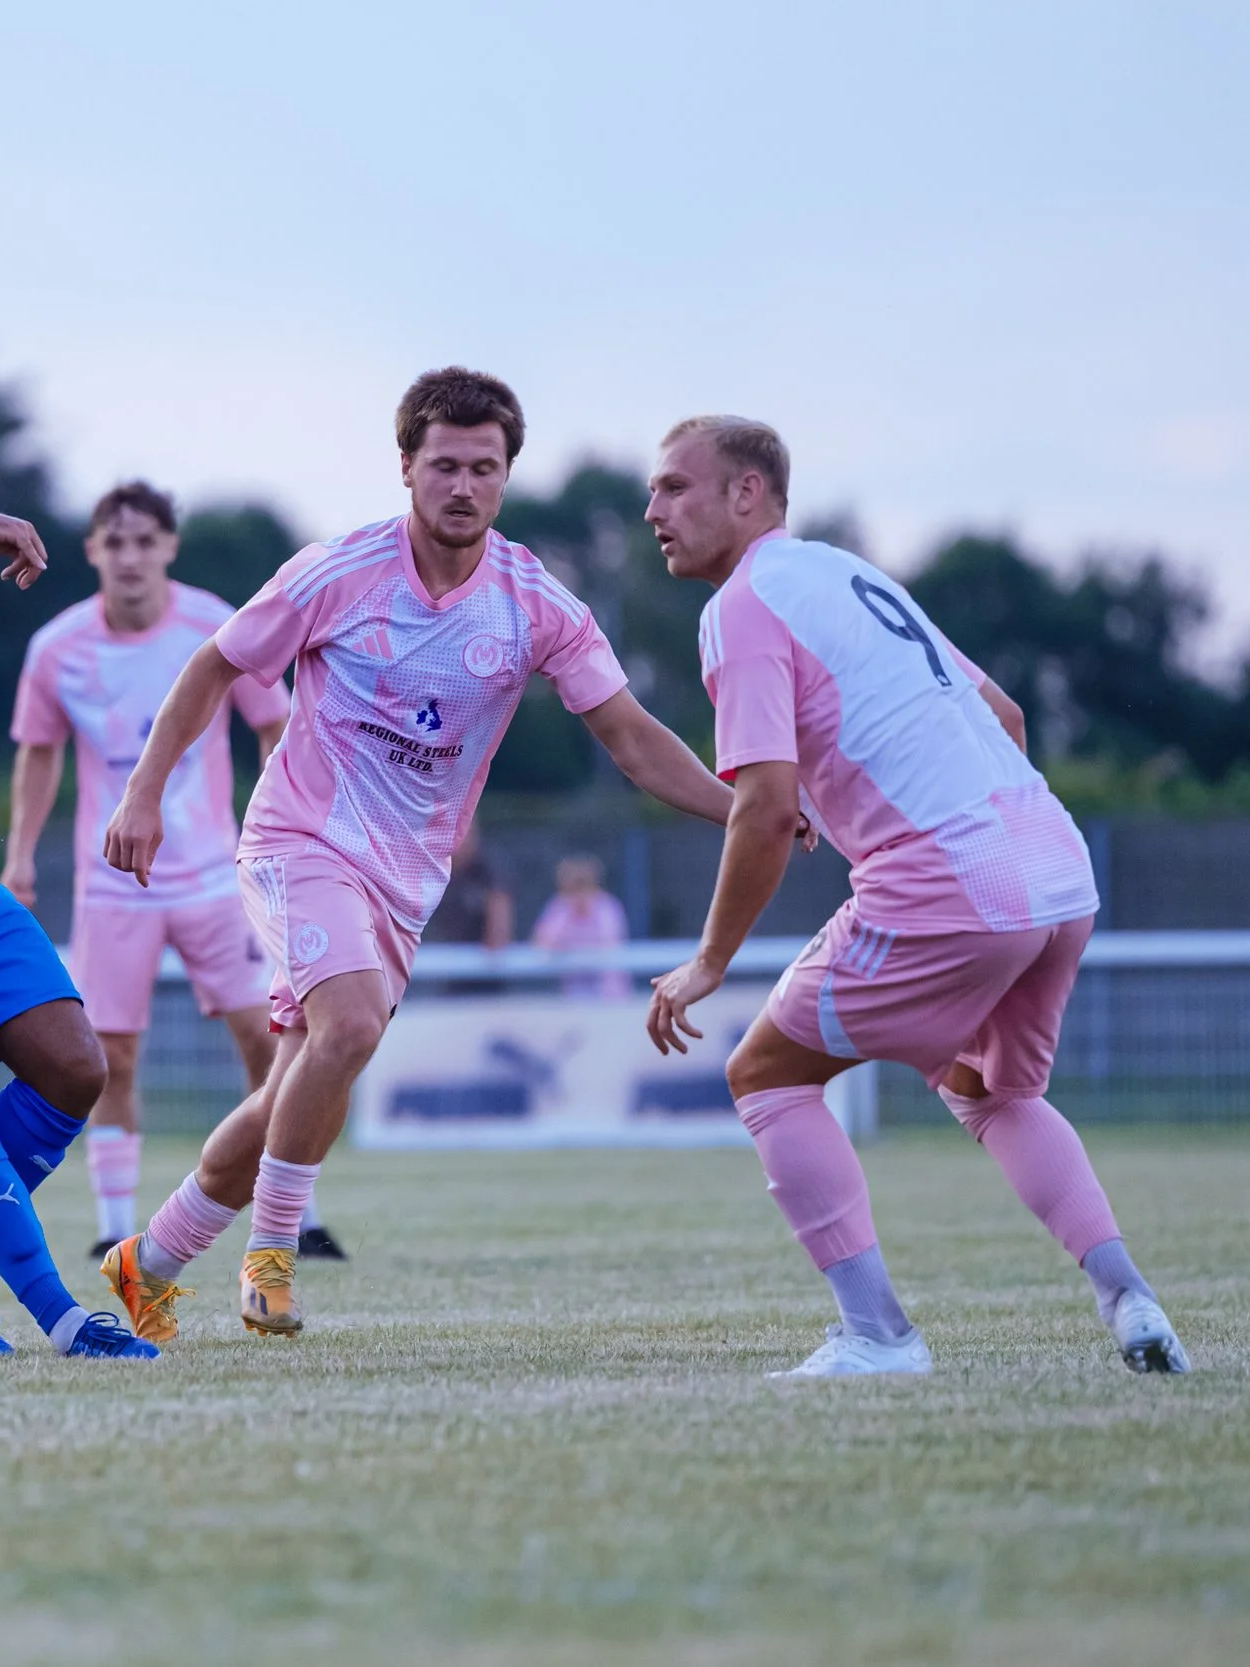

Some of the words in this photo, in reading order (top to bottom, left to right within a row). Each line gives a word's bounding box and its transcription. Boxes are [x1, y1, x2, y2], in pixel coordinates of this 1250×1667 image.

[850, 574, 952, 687] 9
[358, 721, 421, 753] REGIONAL
[422, 744, 464, 758] STEELS
[388, 749, 408, 765] UK
[407, 757, 434, 773] LTD.
